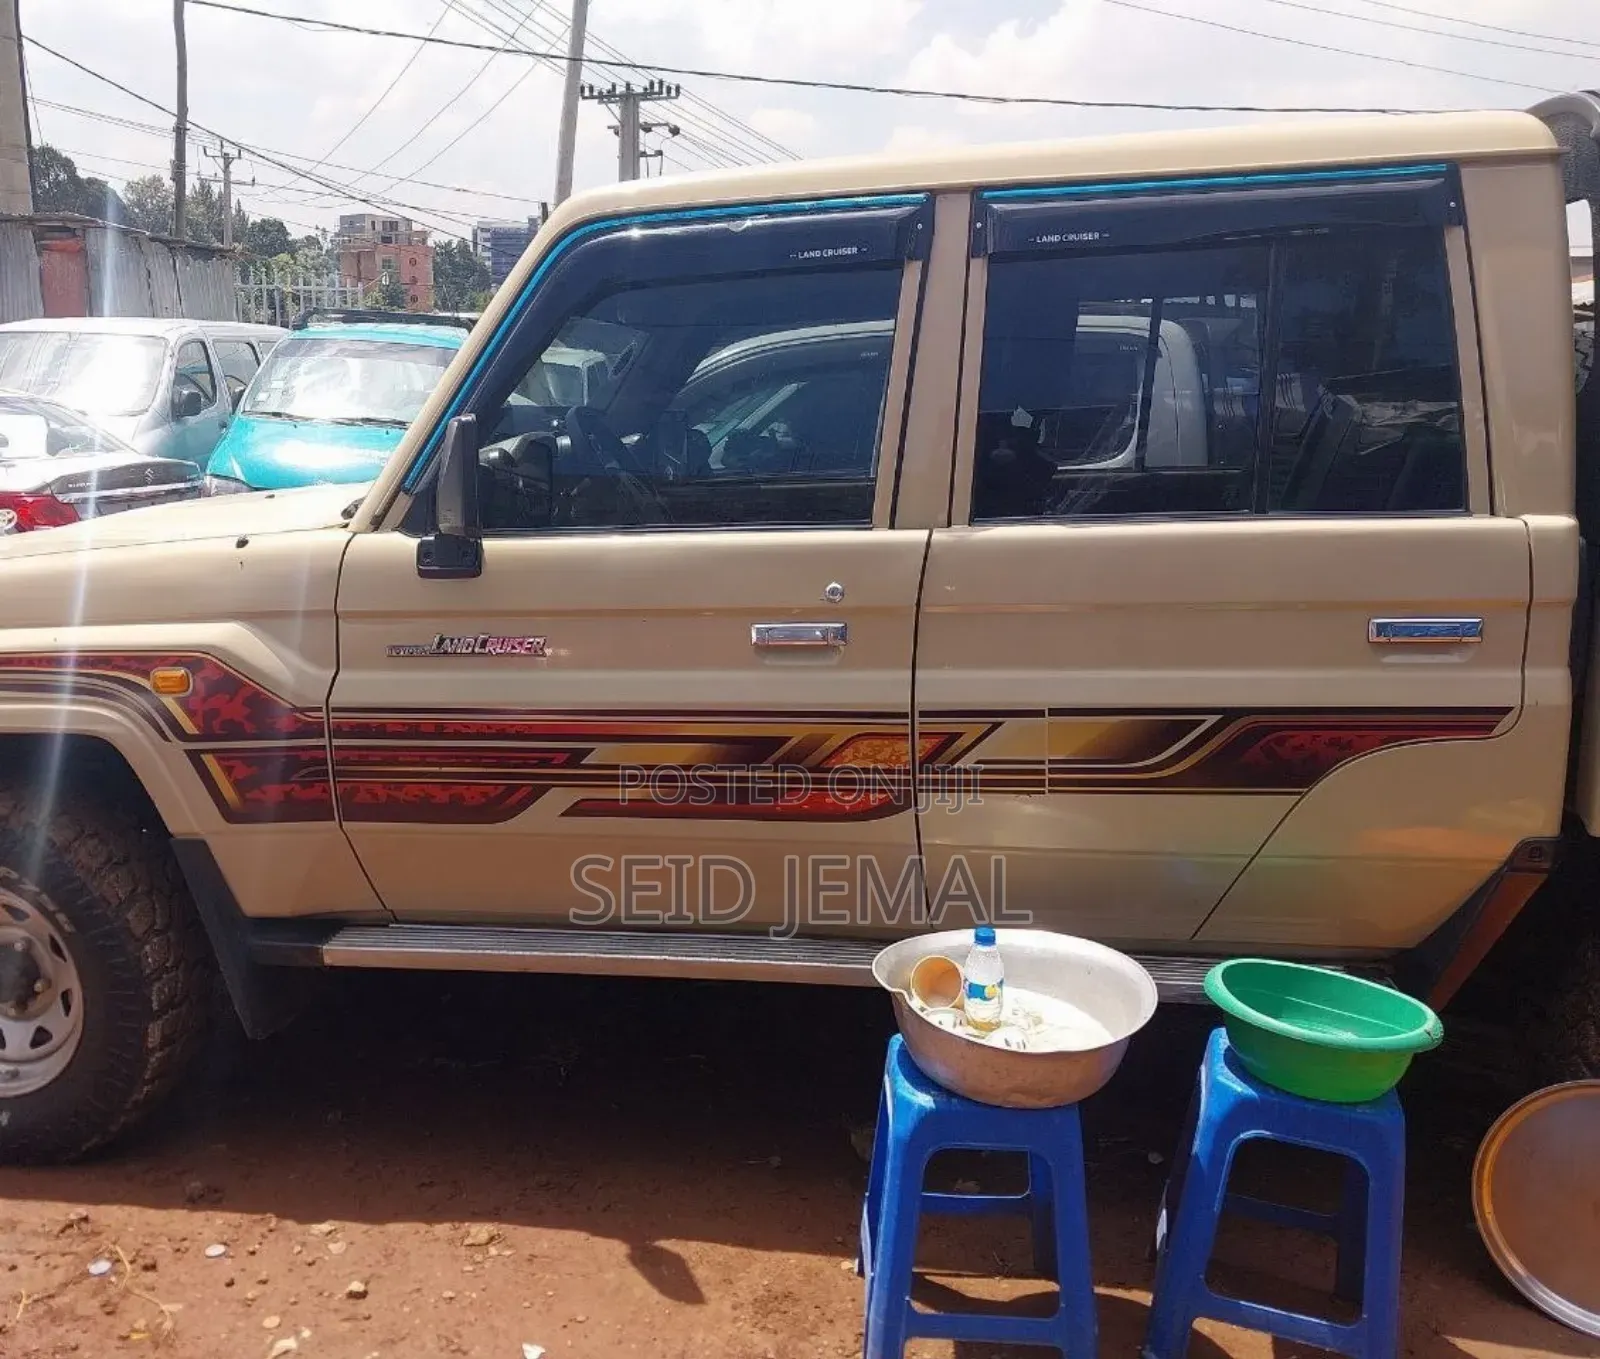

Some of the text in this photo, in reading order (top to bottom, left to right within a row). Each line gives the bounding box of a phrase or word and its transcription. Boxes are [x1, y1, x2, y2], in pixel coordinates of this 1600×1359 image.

[1036, 231, 1099, 243] LAND CRUISER
[798, 247, 858, 259] LAND CRUISER
